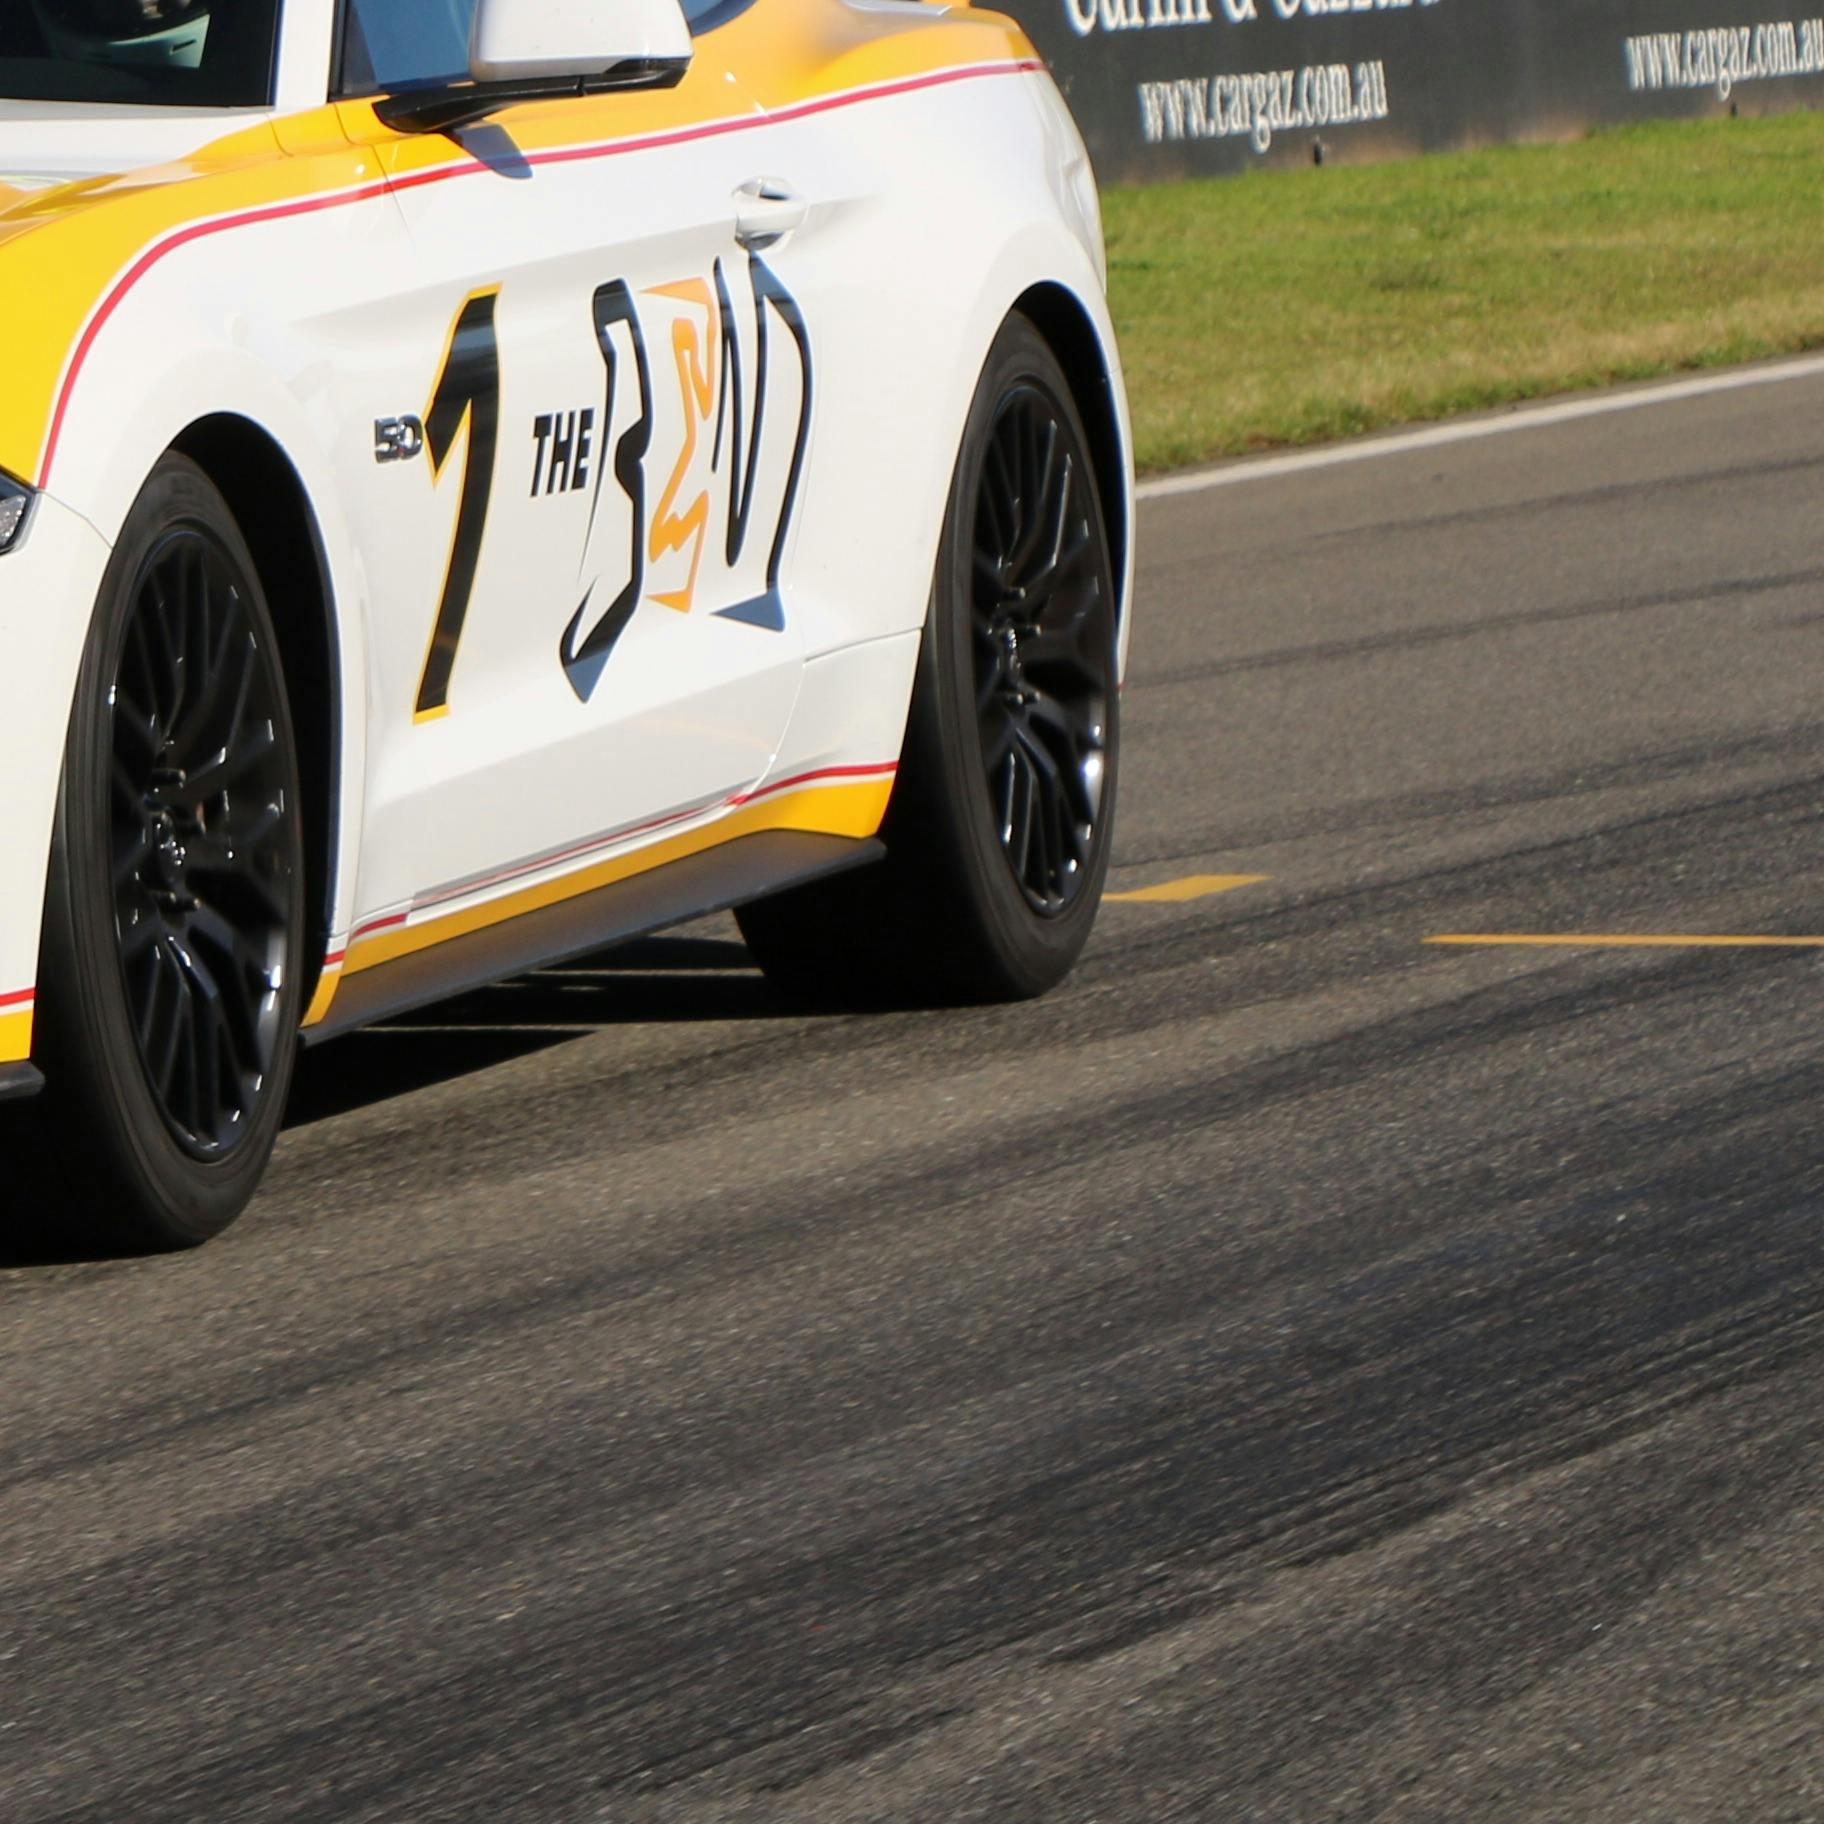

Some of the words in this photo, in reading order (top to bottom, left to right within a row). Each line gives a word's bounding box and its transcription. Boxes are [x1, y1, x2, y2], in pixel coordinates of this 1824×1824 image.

[1138, 60, 1390, 154] www.cargaz.com.au
[530, 407, 595, 498] THE
[412, 282, 503, 726] 1
